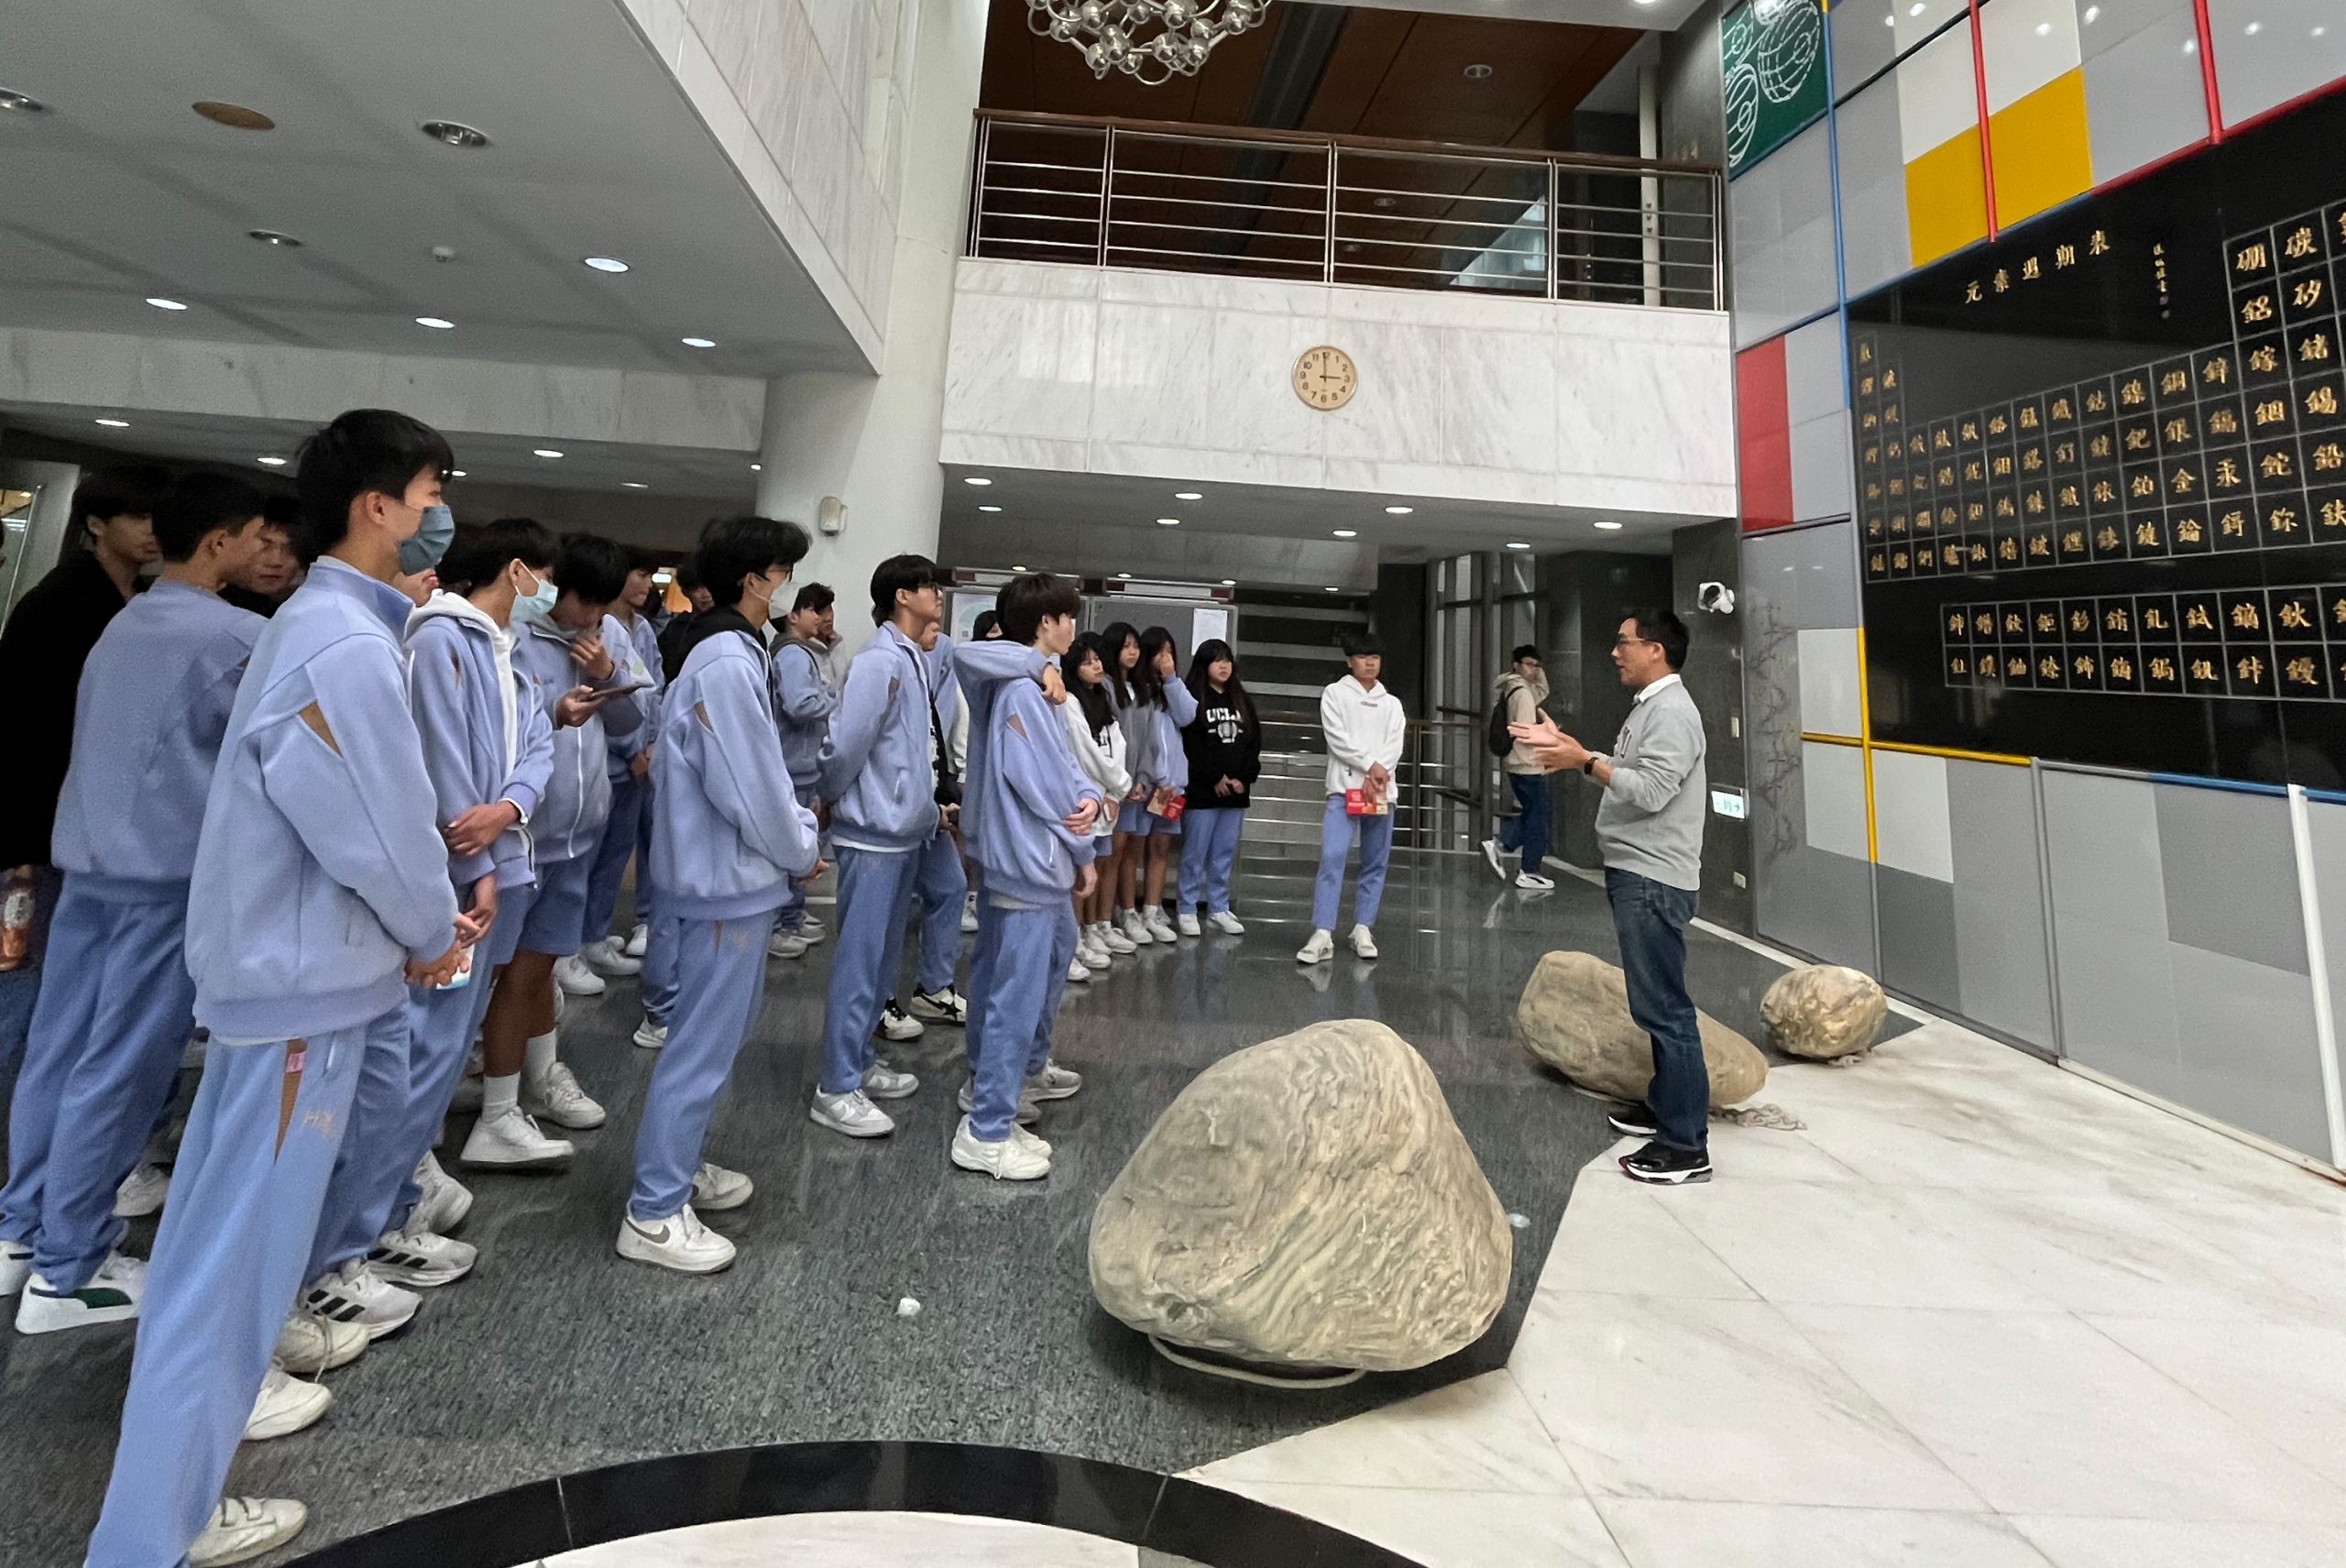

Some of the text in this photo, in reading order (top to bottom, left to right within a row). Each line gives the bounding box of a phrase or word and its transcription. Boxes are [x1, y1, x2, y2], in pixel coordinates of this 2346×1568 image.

[2236, 243, 2267, 272] 硼
[2285, 226, 2318, 258] 碳
[2242, 279, 2322, 323] 鋁 矽
[1343, 364, 1348, 372] 2
[2161, 370, 2187, 395] 銅
[1311, 391, 1317, 400] 7
[2254, 399, 2286, 425] 銦
[2305, 385, 2339, 415] 錫
[2171, 467, 2196, 493] 金
[2216, 457, 2242, 488] 汞
[2260, 451, 2292, 478] 鉈
[2313, 442, 2344, 471] 鉛
[2320, 499, 2346, 527] 鈇
[2145, 609, 2169, 629] 釓
[2279, 600, 2311, 629] 鈥
[2238, 656, 2264, 685] 鉲
